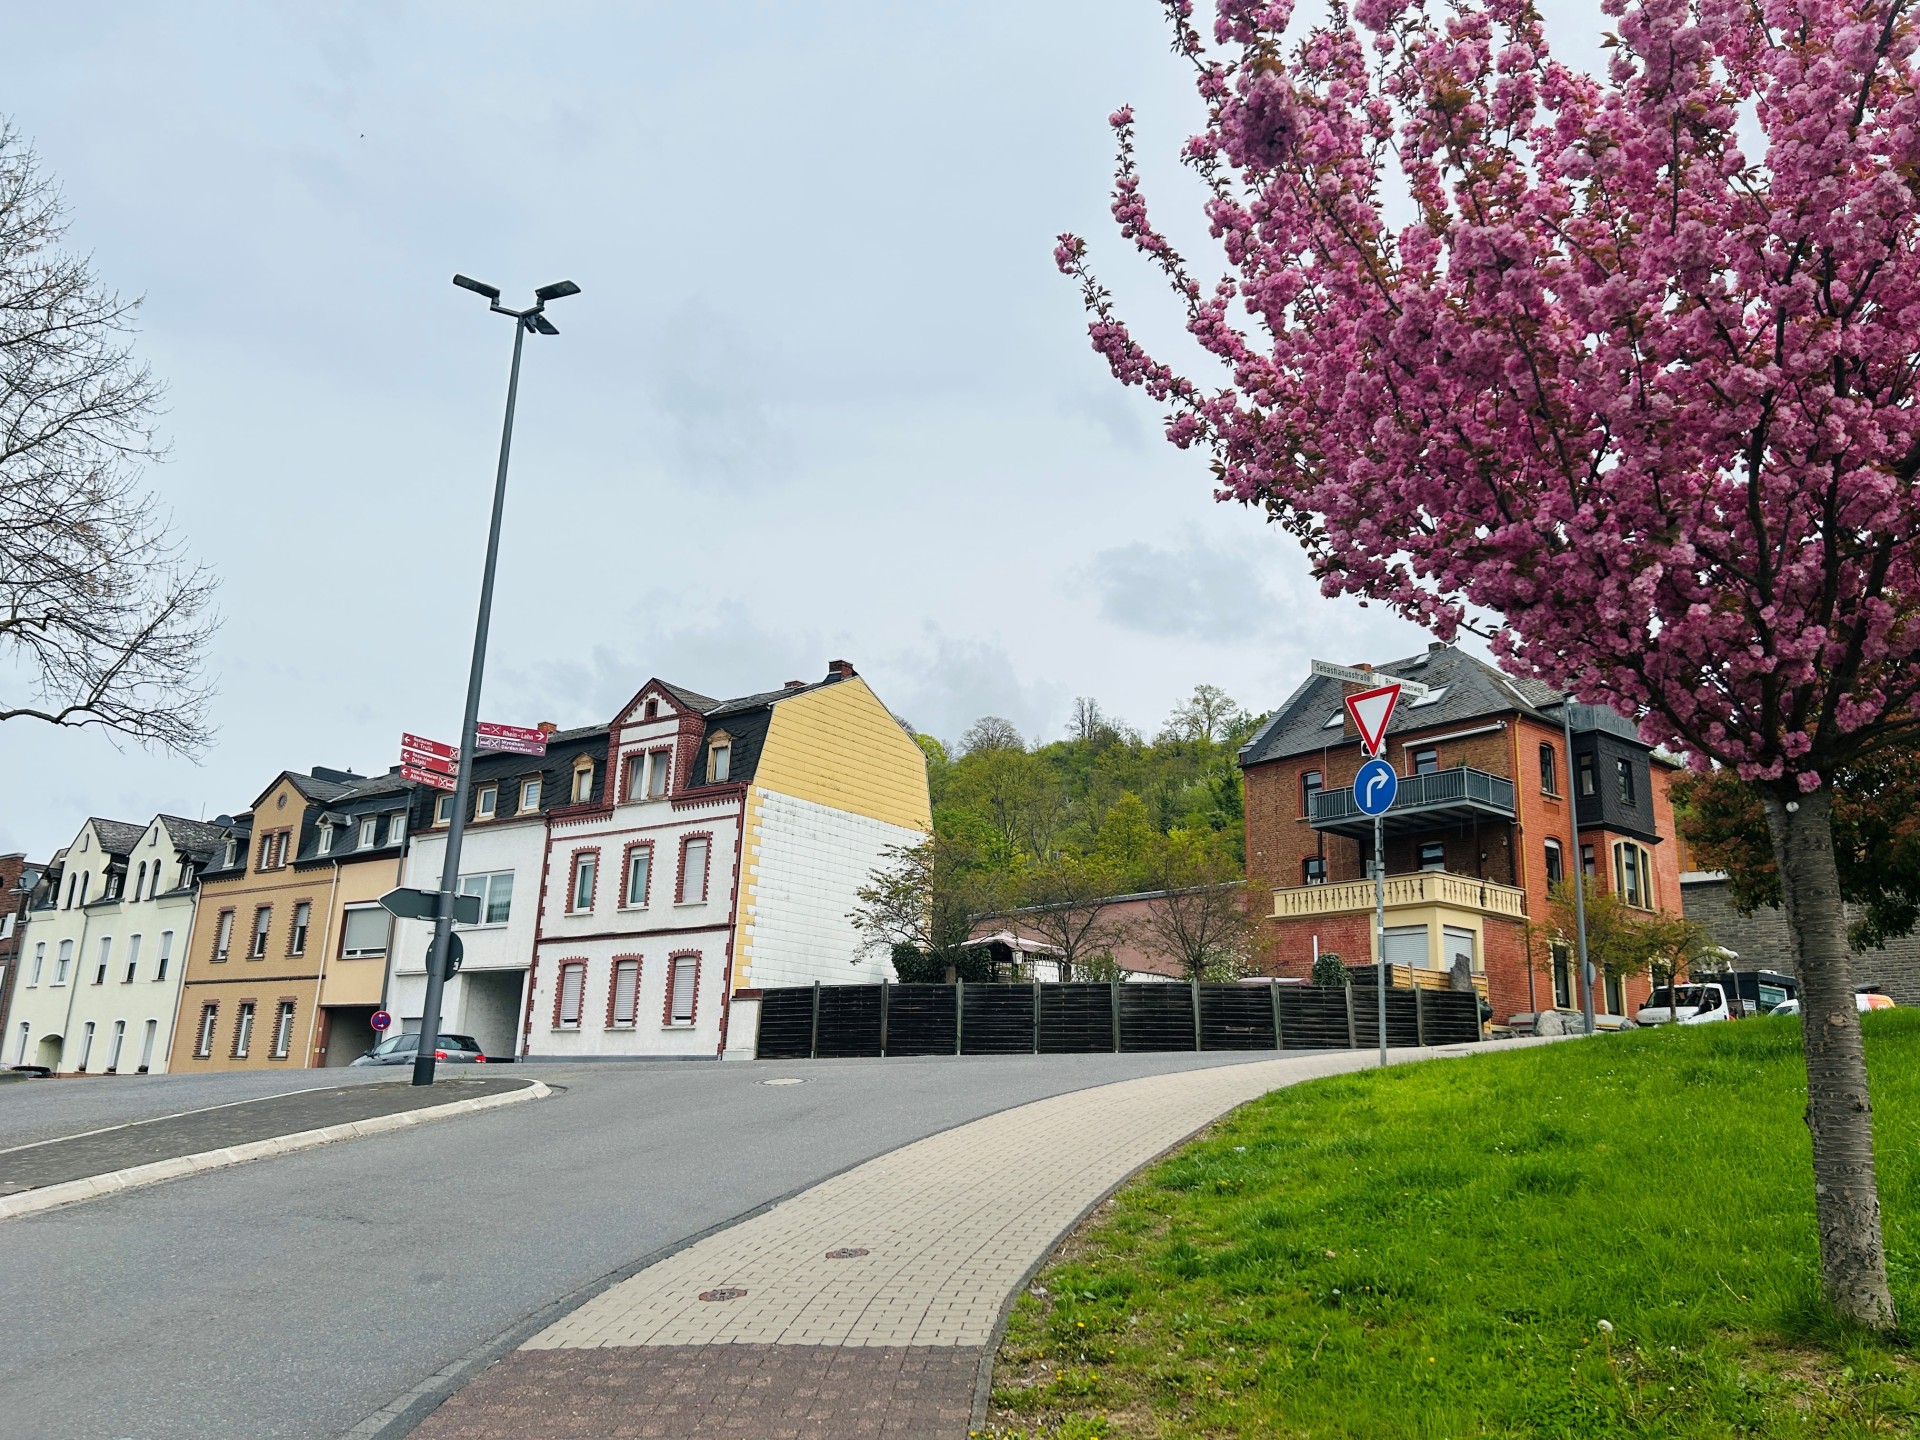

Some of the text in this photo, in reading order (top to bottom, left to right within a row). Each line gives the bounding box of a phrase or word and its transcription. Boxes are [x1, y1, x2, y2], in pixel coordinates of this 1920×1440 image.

[1315, 662, 1371, 682] Sebastianusstraße
[411, 757, 427, 766] Delphi
[423, 776, 435, 785] Haus
